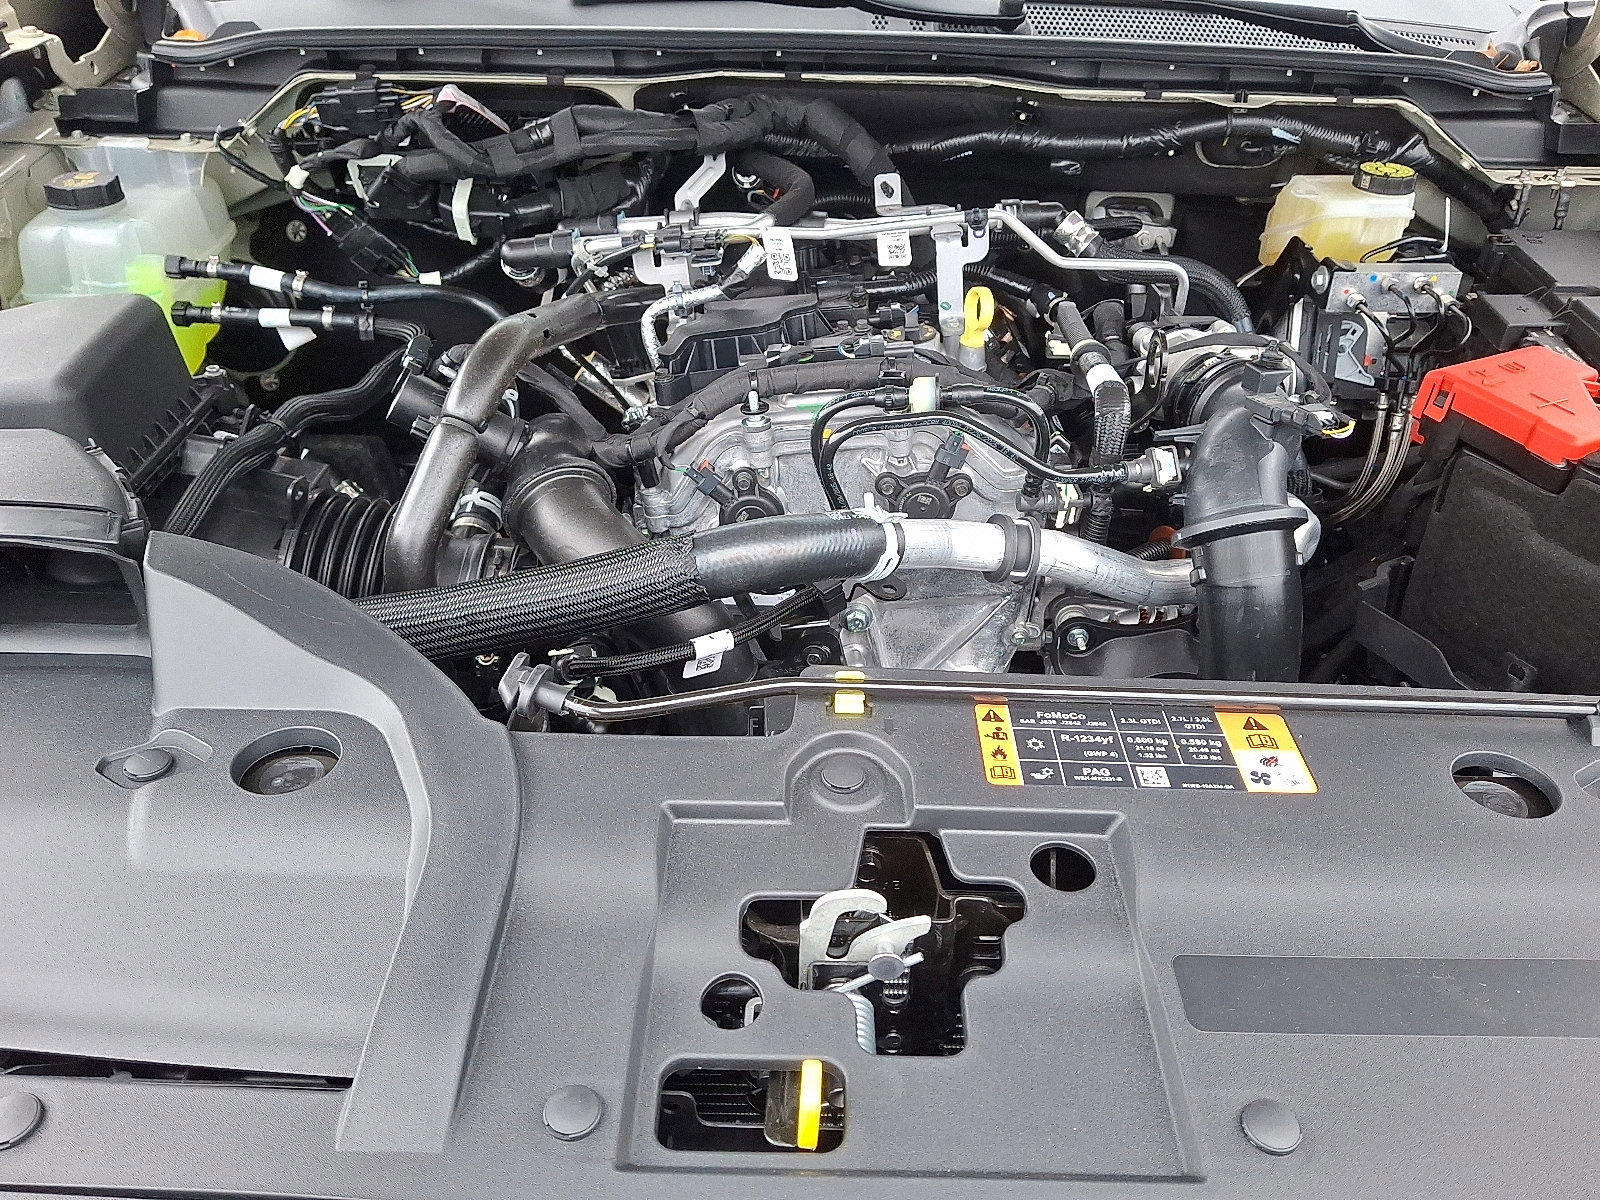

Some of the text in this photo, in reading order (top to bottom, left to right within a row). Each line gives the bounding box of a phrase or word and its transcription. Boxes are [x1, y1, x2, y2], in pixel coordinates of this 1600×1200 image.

[1036, 711, 1086, 720] FoMoCo
[1060, 734, 1114, 745] R-1234yf
[1155, 738, 1169, 746] kg
[1208, 739, 1223, 748] kg
[1084, 750, 1108, 758] (GWP
[1082, 767, 1112, 777] PAG
